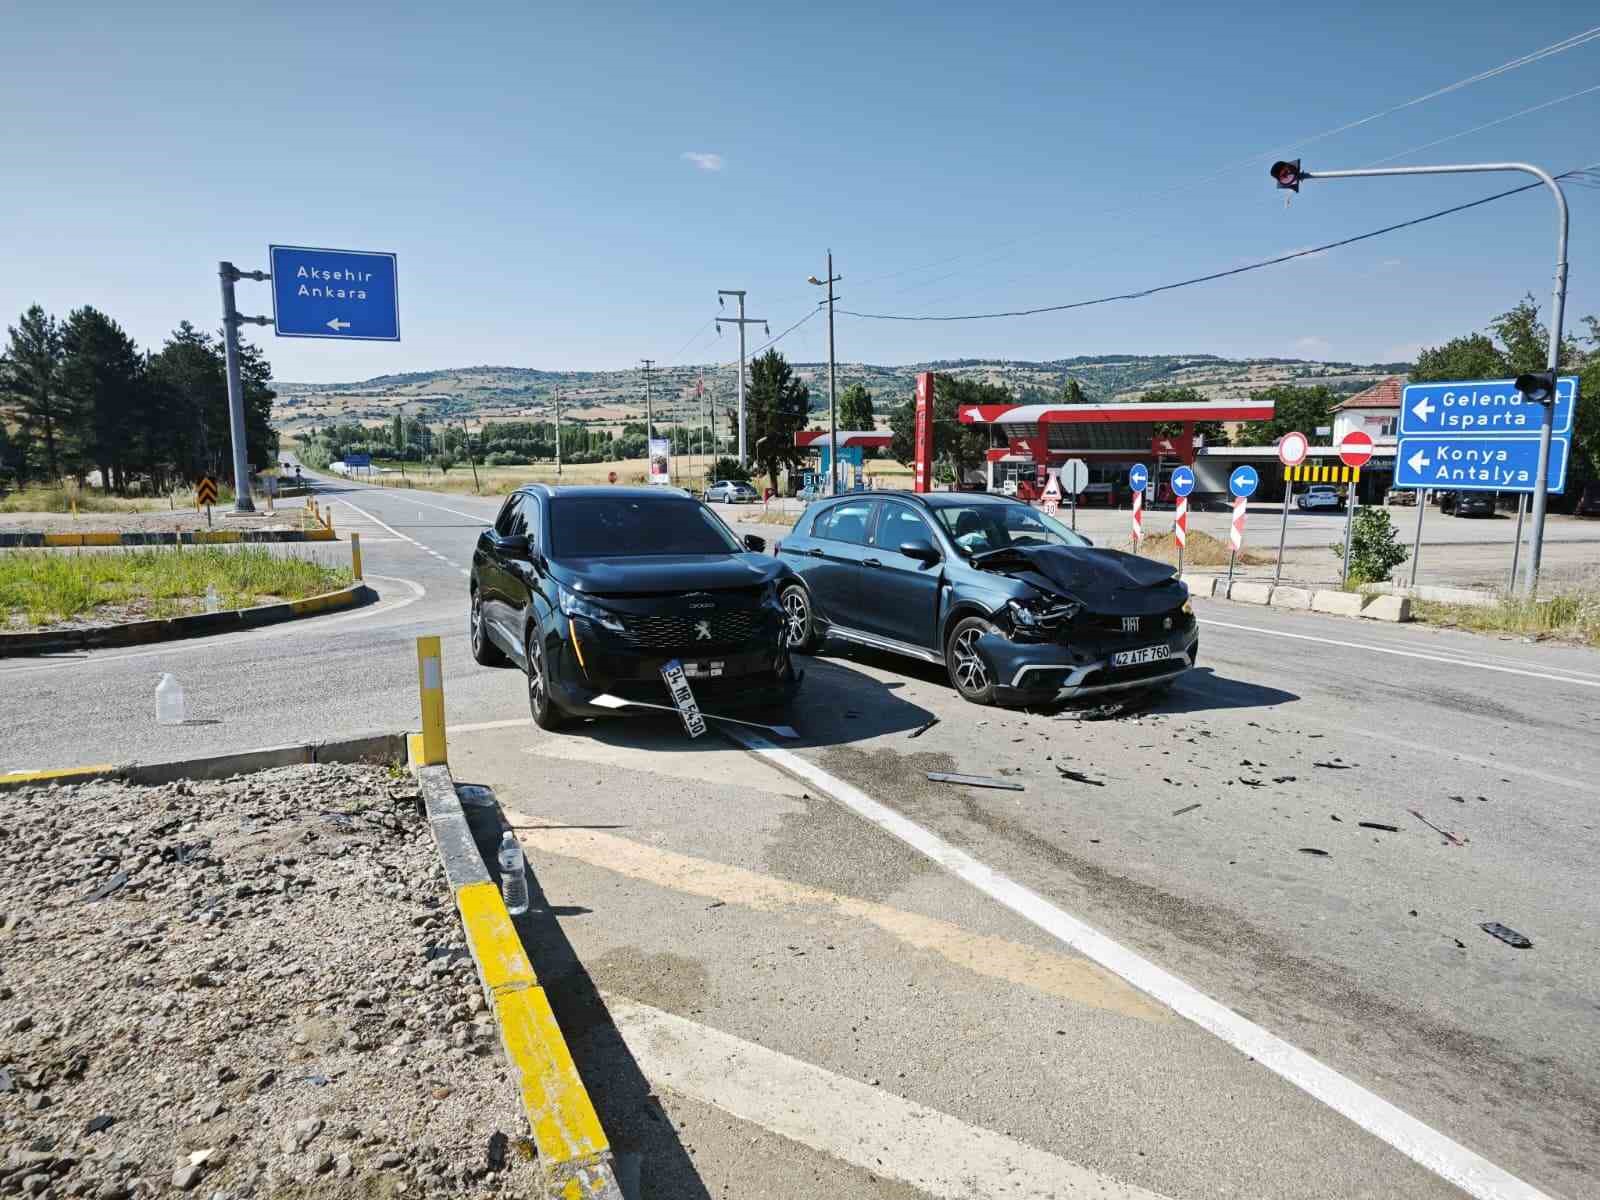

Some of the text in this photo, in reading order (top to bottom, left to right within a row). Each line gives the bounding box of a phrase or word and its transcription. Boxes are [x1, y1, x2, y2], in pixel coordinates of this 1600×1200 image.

[298, 284, 367, 299] Ankara
[1442, 391, 1561, 406] Gelendt
[1440, 411, 1526, 429] Isparta
[1436, 446, 1507, 464] Konya
[1435, 464, 1529, 484] Antalya
[1122, 616, 1140, 632] FIAT
[1115, 646, 1169, 665] 42 ATF 760
